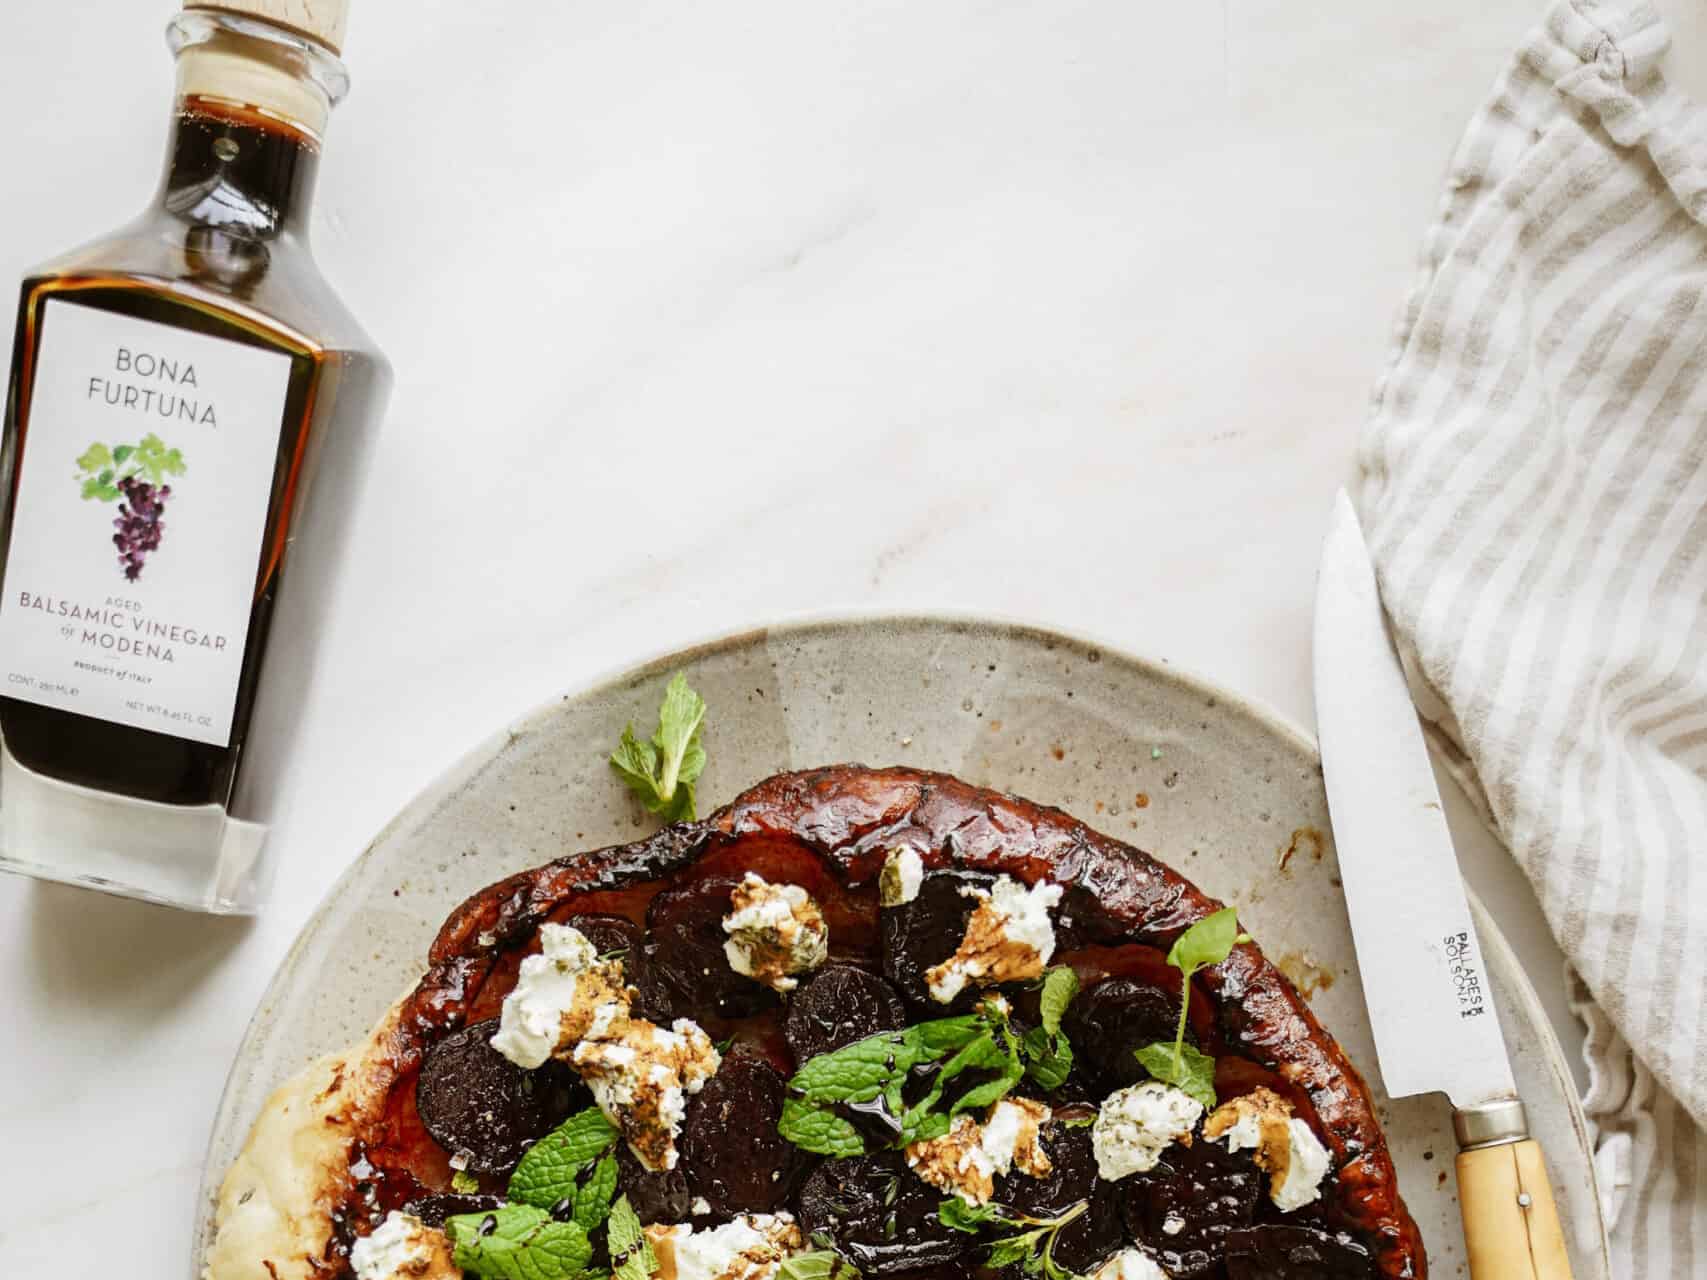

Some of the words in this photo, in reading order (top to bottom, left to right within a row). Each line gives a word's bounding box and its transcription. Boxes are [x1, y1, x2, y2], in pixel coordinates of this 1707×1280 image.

[116, 348, 198, 388] BONA
[88, 377, 217, 428] FURTUNA
[20, 591, 125, 630] BALSAMIC
[132, 615, 227, 651] VINEGAR
[105, 596, 142, 613] AGED
[81, 629, 175, 663] MODENA
[1443, 936, 1468, 1005] SOLSONA
[1456, 932, 1482, 1005] PALLARES
